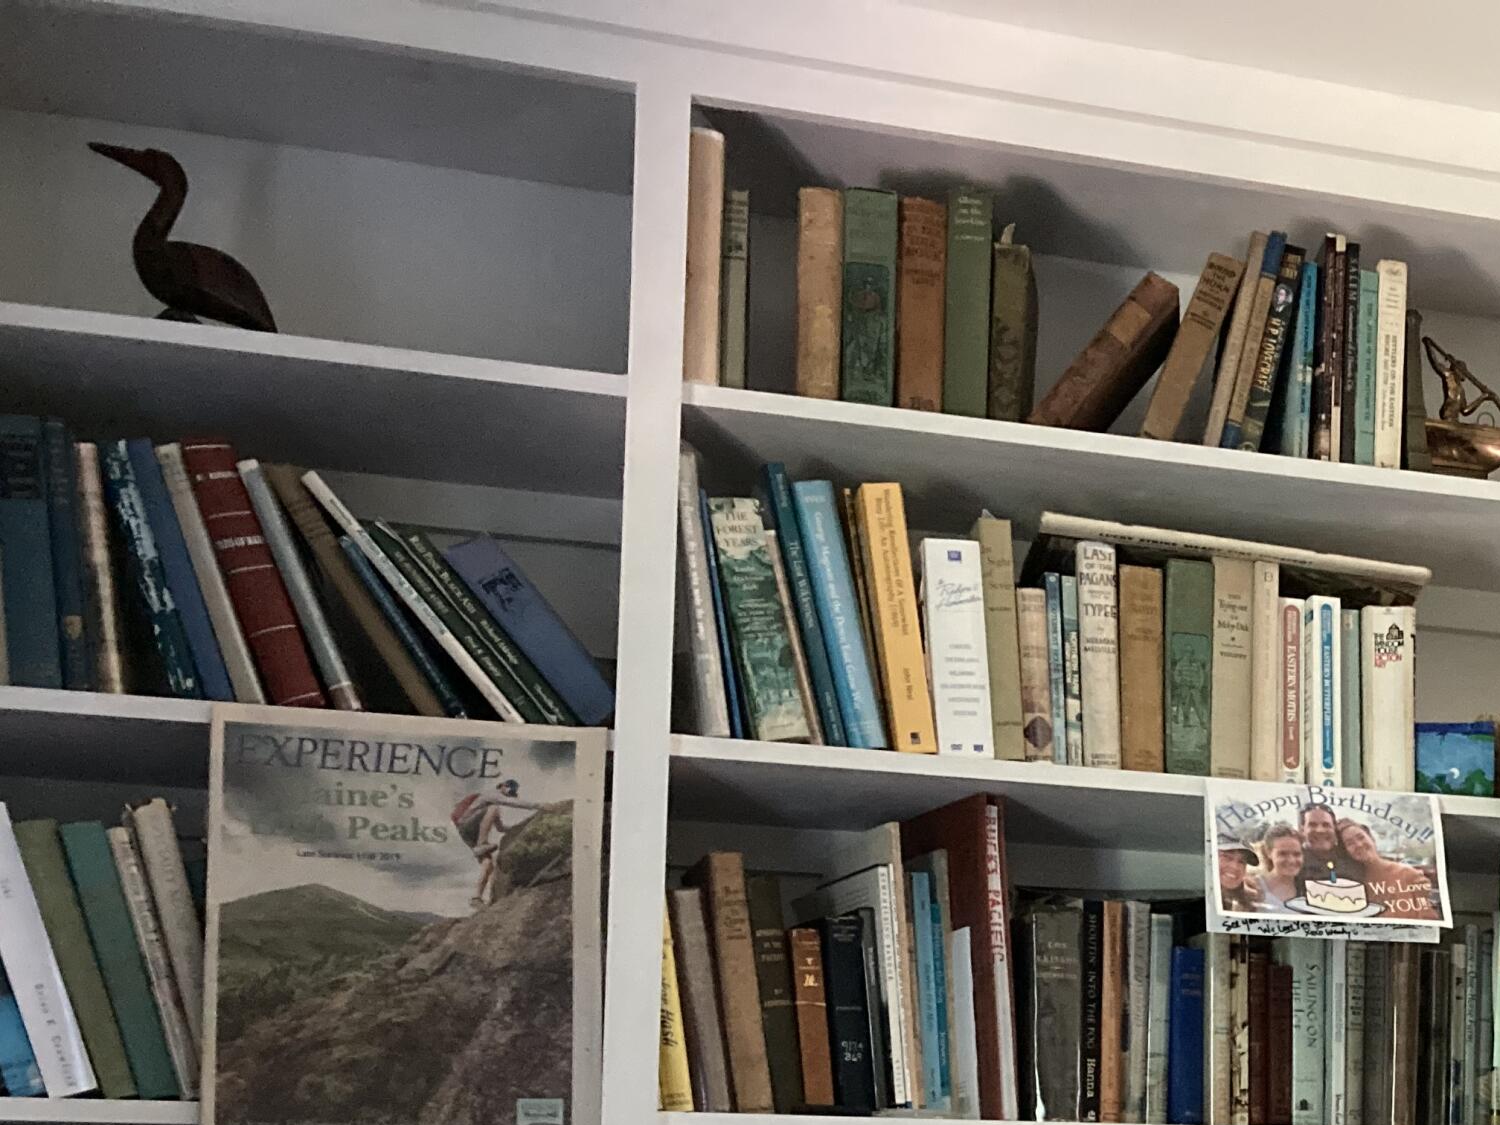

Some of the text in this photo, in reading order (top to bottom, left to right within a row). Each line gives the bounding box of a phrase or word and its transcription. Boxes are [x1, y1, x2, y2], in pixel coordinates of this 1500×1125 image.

[1347, 257, 1358, 300] SALEM
[1253, 337, 1277, 390] LOVECRAFT
[716, 524, 758, 536] FOREST
[721, 536, 760, 548] YEARS
[1083, 547, 1113, 562] LAST
[1079, 572, 1117, 587] PAGANS
[1083, 603, 1117, 619] TYPEE
[1286, 644, 1296, 721] EASTERN MOTHS
[237, 733, 504, 778] EXPERIENCE
[316, 781, 414, 808] aine's
[1216, 795, 1300, 831] Happy
[348, 815, 448, 842] Peaks
[1396, 880, 1432, 893] Love
[1087, 970, 1096, 999] INTO
[1087, 1002, 1096, 1023] THE
[1305, 963, 1320, 1047] SAILING ON
[1087, 1027, 1096, 1048] FOG
[1086, 1058, 1095, 1098] Hanna
